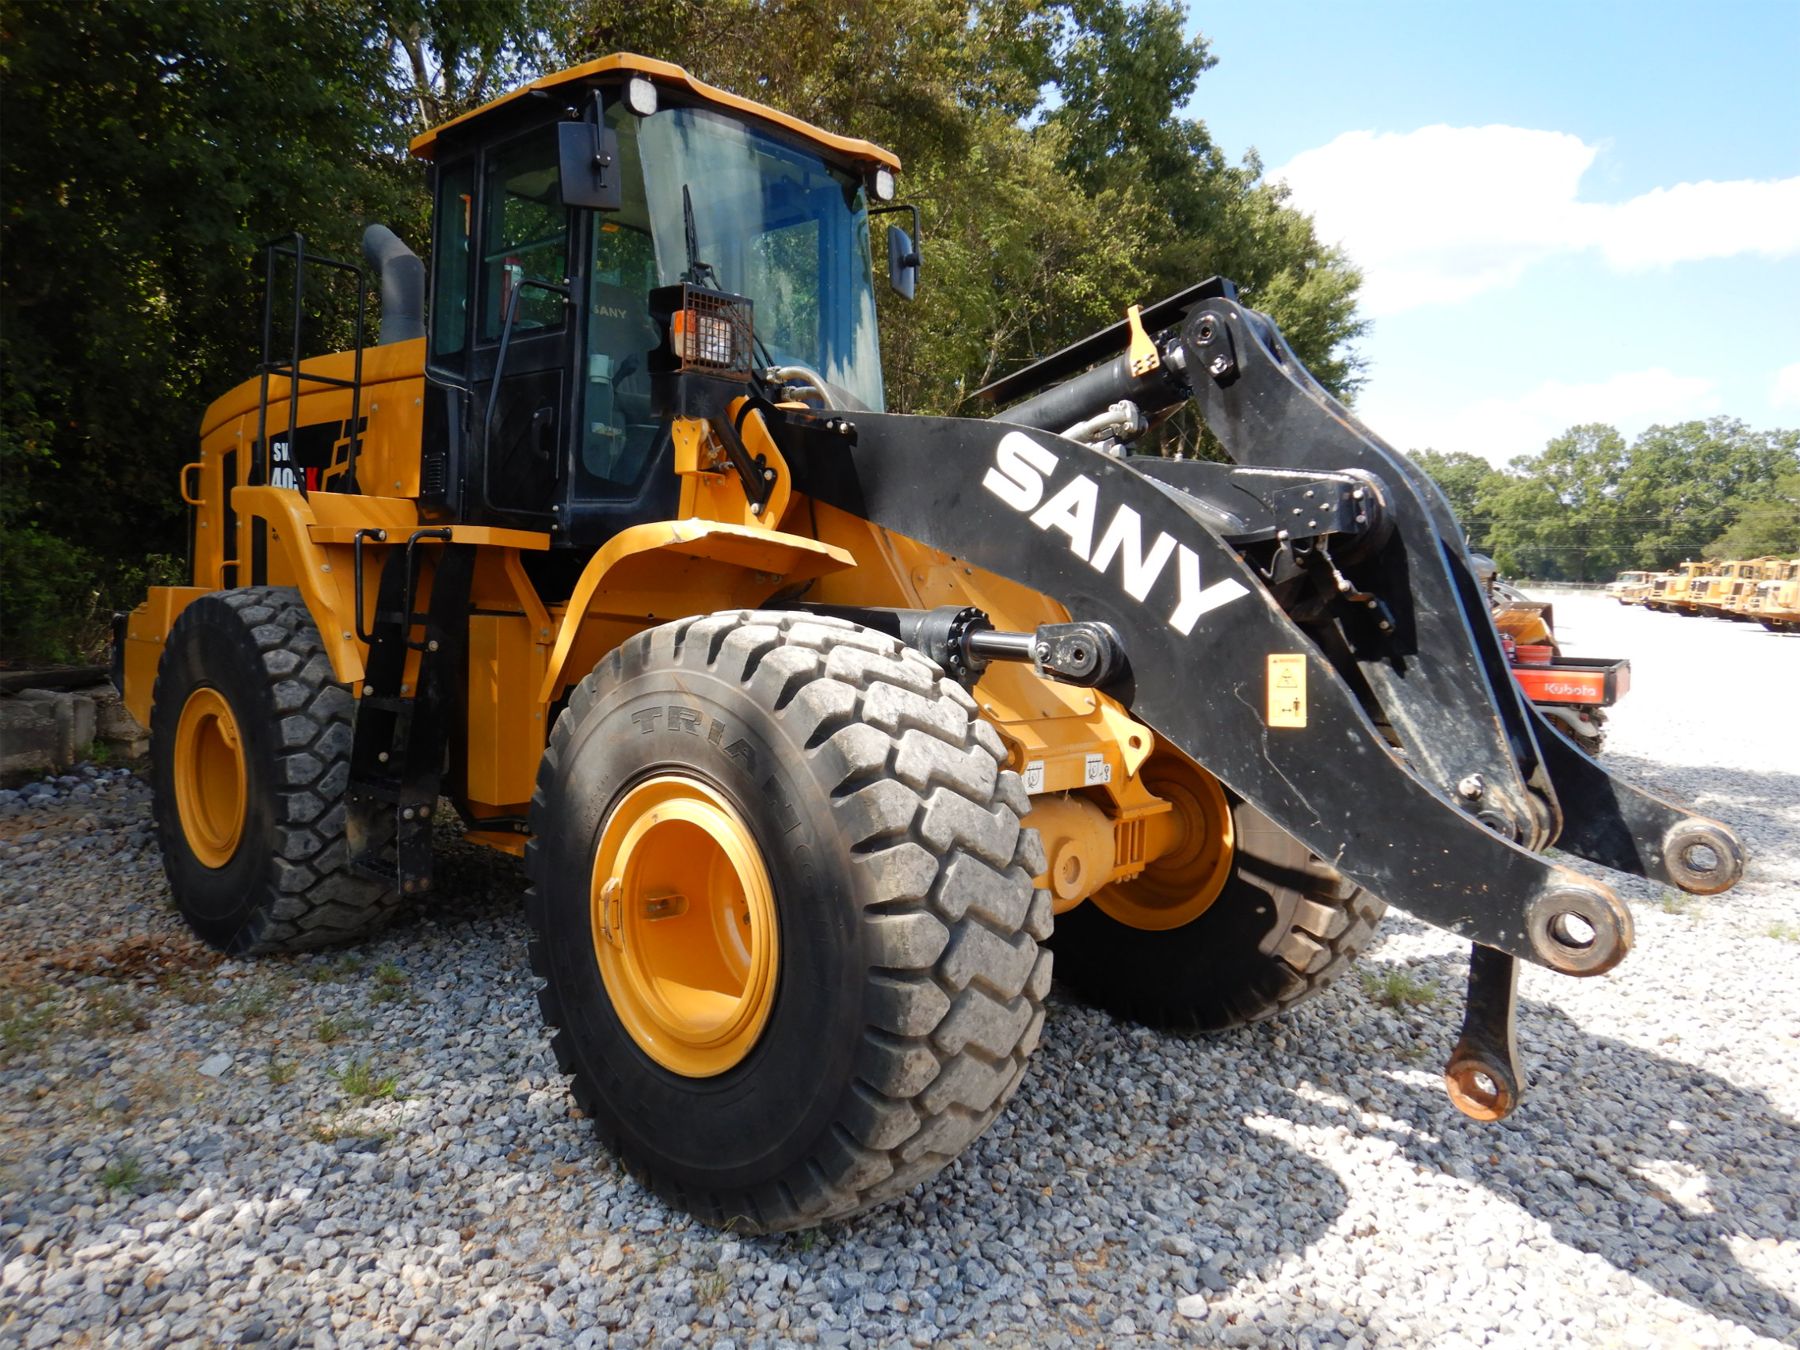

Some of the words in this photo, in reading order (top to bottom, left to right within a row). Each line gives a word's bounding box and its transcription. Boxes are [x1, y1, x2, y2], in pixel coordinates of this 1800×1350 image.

[592, 304, 628, 320] SANY
[982, 431, 1251, 636] SANY
[1544, 682, 1597, 696] Kubota
